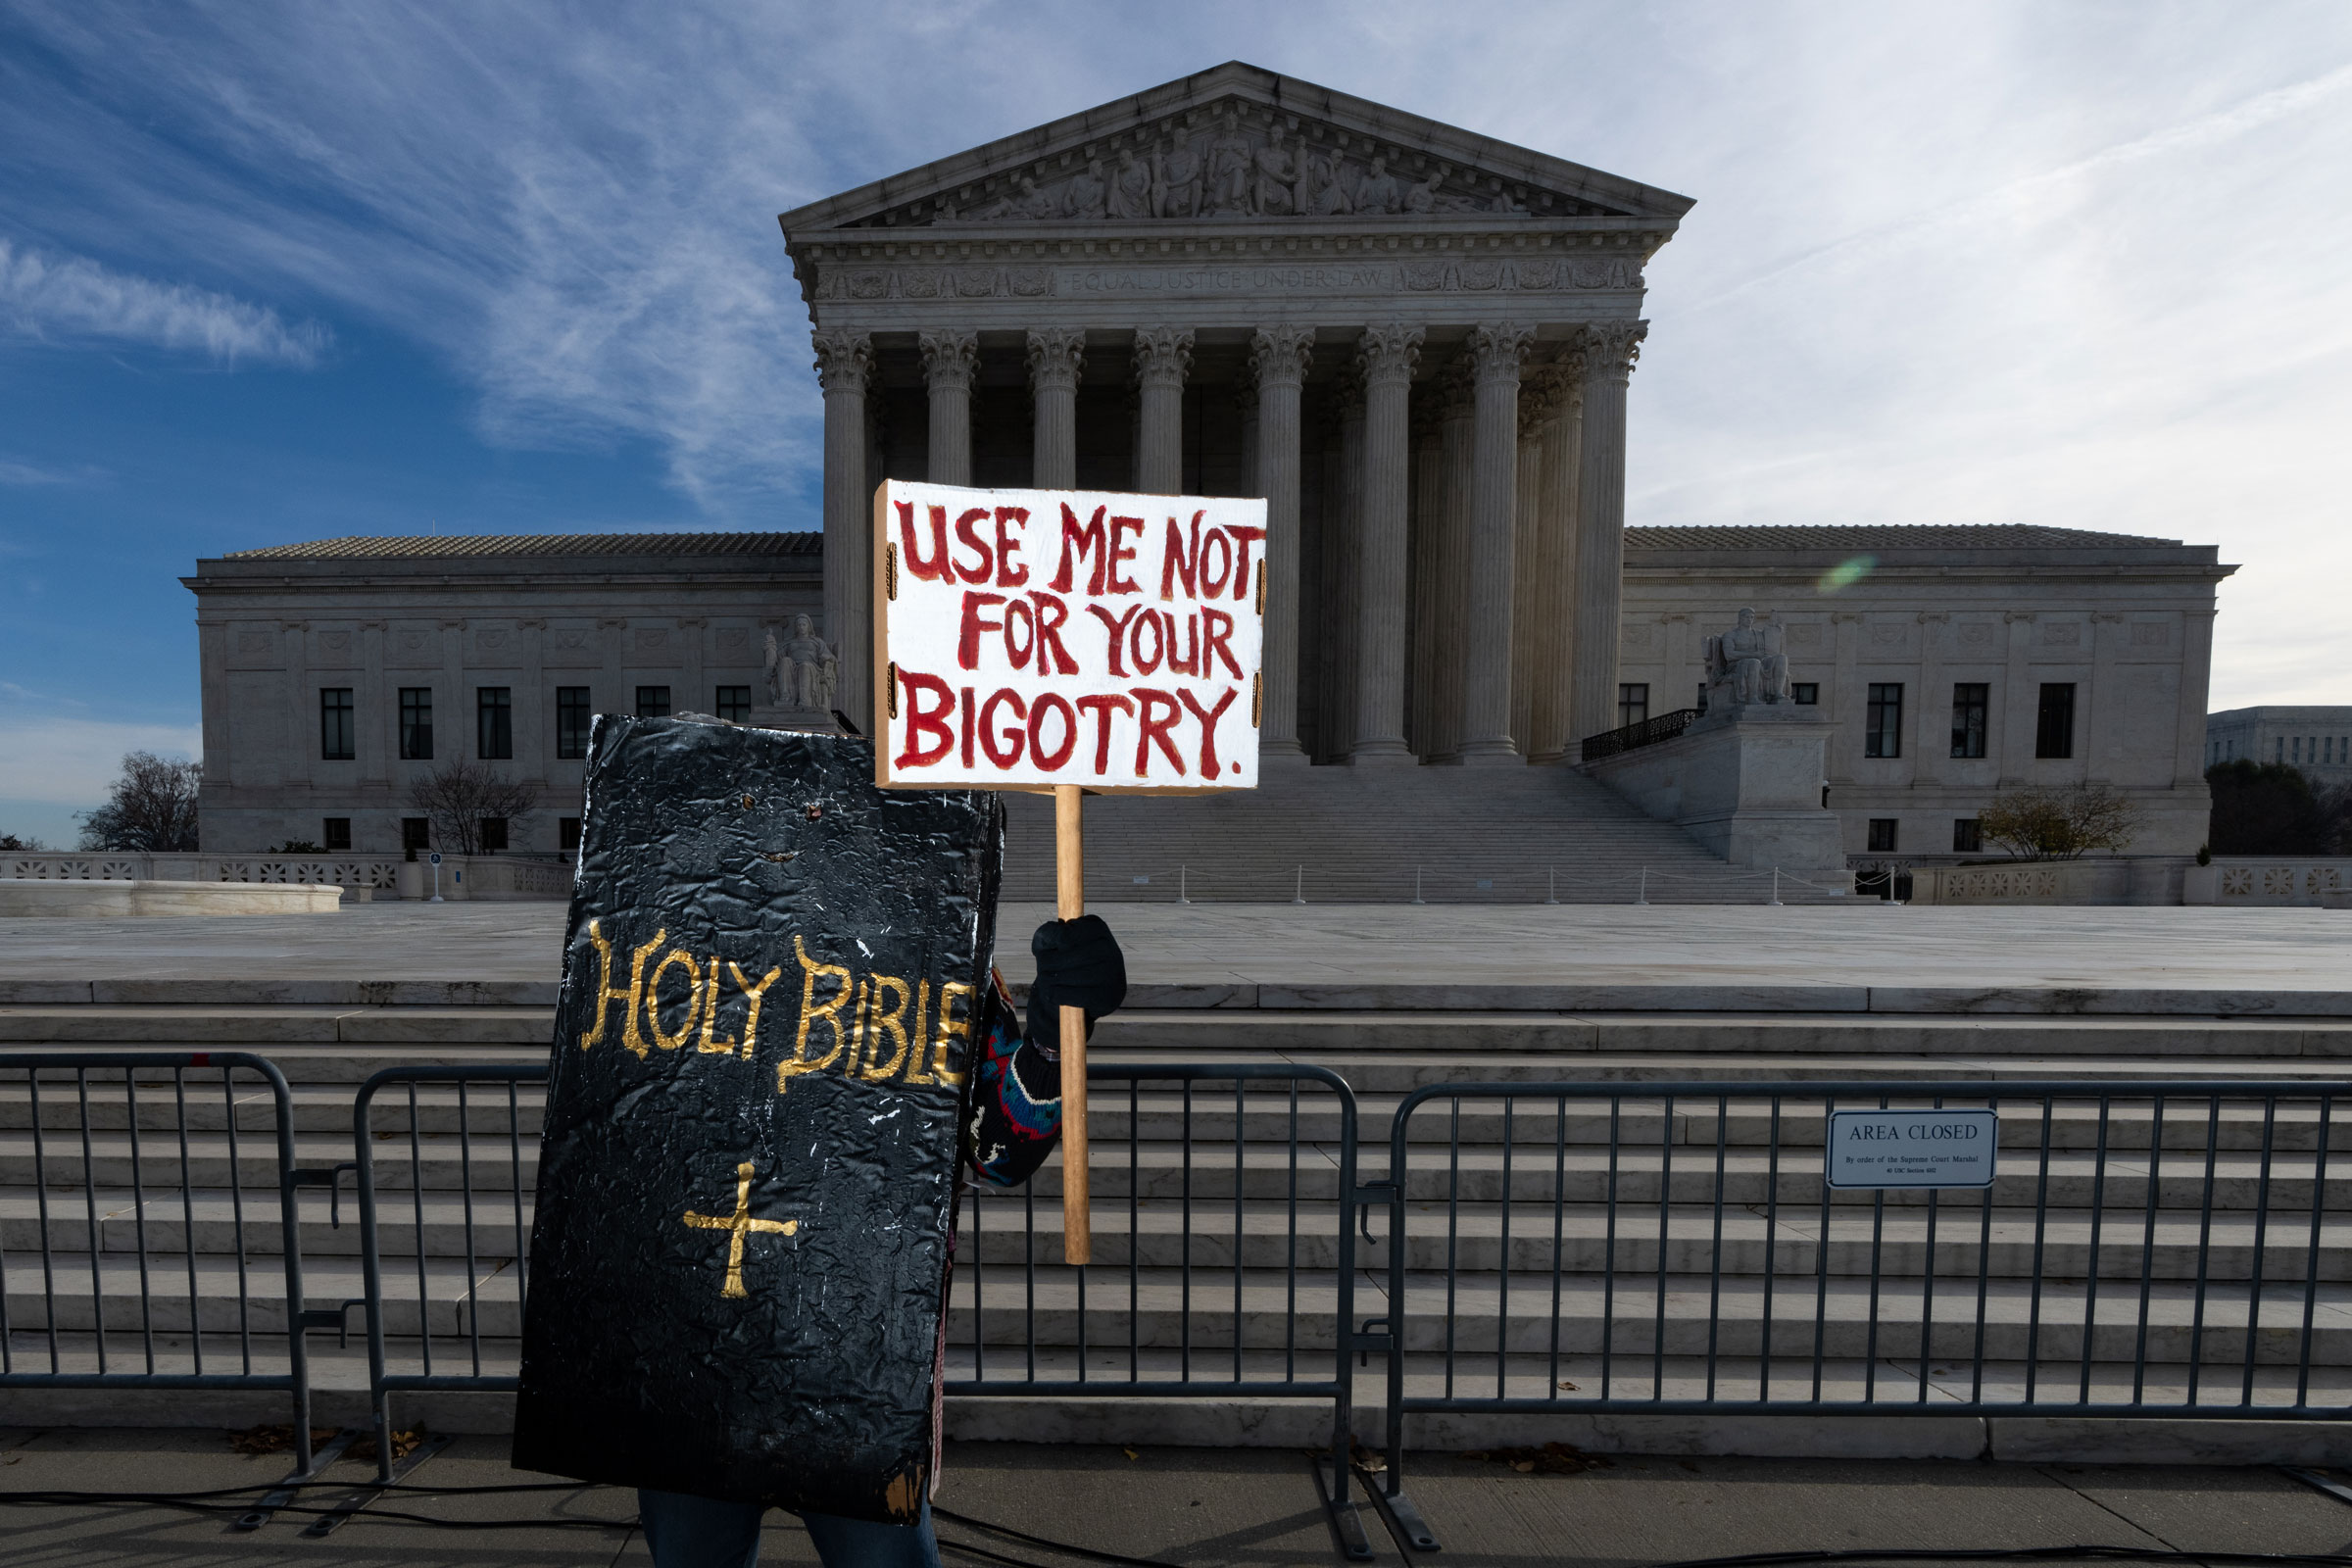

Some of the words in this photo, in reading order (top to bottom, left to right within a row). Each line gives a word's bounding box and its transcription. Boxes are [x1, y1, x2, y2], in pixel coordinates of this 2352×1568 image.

[1071, 272, 1148, 292] EQUAL
[1152, 270, 1242, 291] JUSTICE
[1253, 270, 1329, 290] UNDER
[1337, 269, 1382, 288] LAW
[893, 500, 1031, 588] USE
[1048, 501, 1146, 596] ME
[1159, 510, 1267, 602] NOT
[957, 590, 1079, 677] FOR
[1085, 603, 1245, 681] YOUR
[893, 666, 1242, 781] BIGOTRY.
[580, 918, 782, 1062] HOLY
[776, 934, 977, 1095] BIBLE
[1845, 1155, 1854, 1164] By
[1900, 1155, 1929, 1164] Supreme
[1952, 1154, 1979, 1163] Marshal
[1849, 1125, 1900, 1141] AREA
[1908, 1124, 1978, 1140] CLOSED
